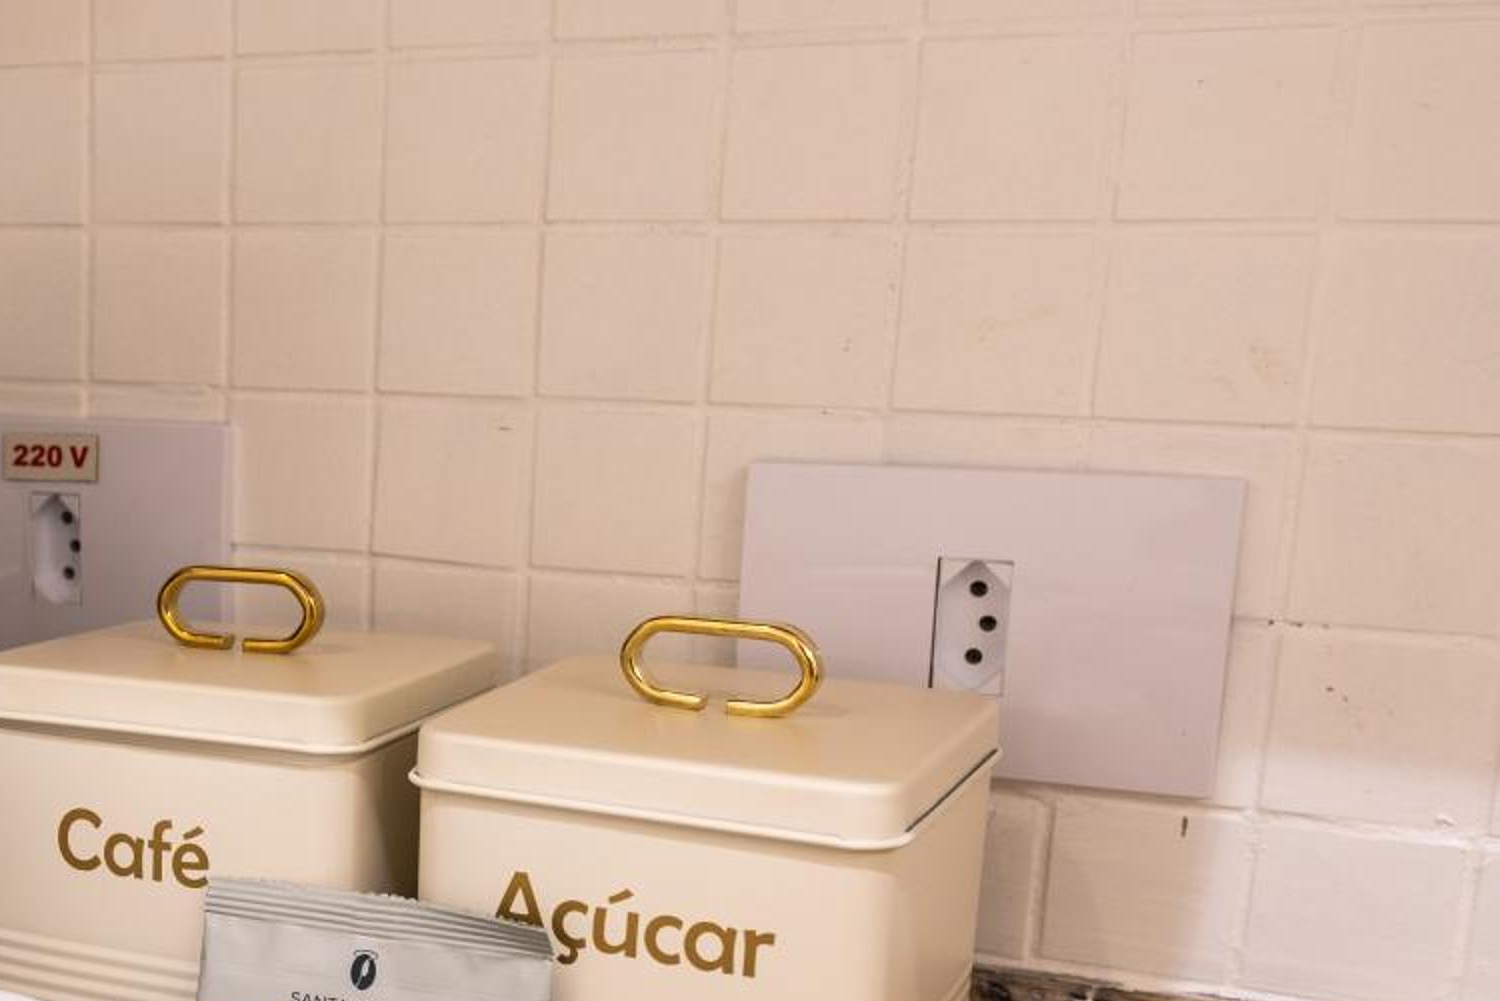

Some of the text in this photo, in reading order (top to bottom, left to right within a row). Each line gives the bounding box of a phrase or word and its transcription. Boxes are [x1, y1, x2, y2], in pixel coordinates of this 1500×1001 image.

[12, 444, 89, 468] 220 V
[57, 807, 210, 889] Café
[495, 871, 776, 978] Açúcar
